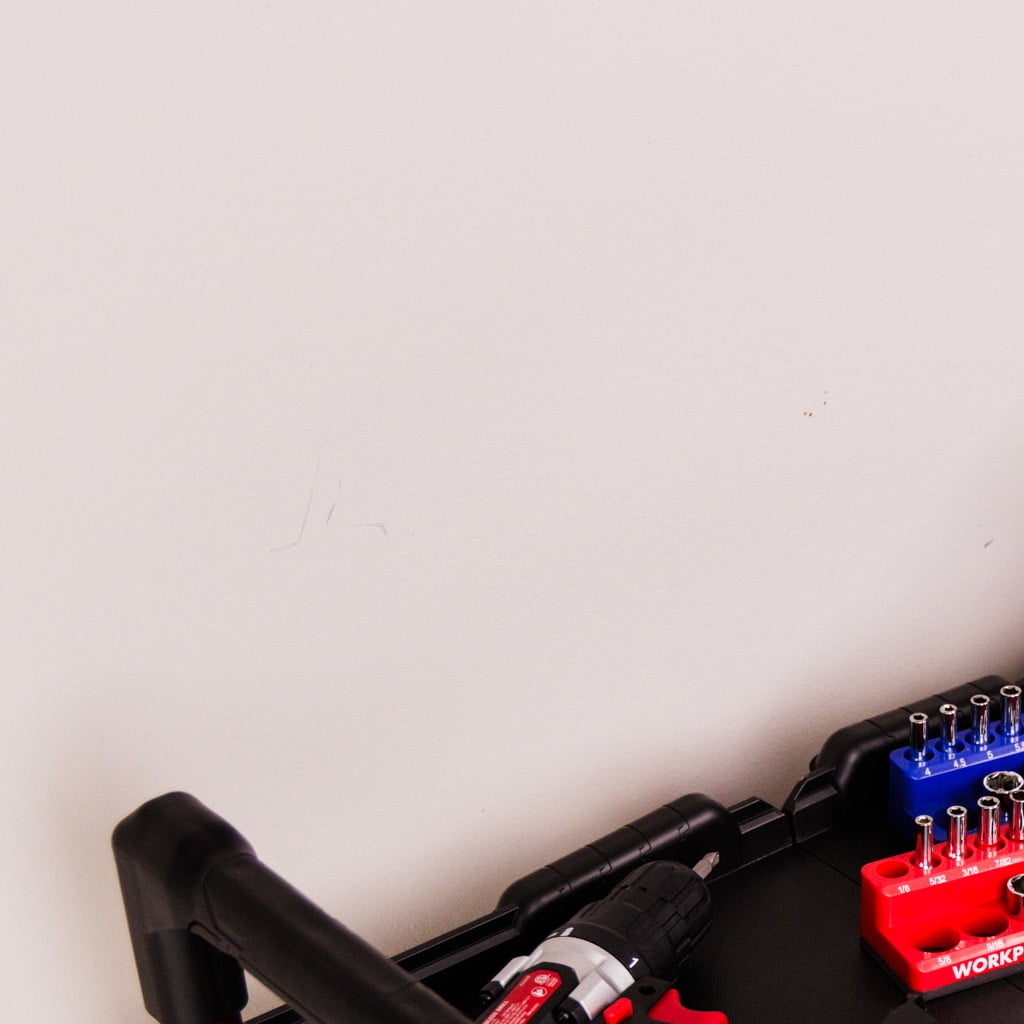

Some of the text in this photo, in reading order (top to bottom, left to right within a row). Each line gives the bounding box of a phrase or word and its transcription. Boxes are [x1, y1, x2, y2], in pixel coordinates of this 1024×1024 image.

[924, 767, 932, 776] 4
[953, 758, 967, 768] 4.5
[987, 751, 993, 759] 5
[898, 885, 911, 894] 1/8
[928, 875, 947, 886] 5/32
[962, 866, 980, 877] 3/16
[994, 857, 1012, 867] 7/32
[938, 955, 951, 966] 5/8
[986, 940, 1003, 951] 9/16
